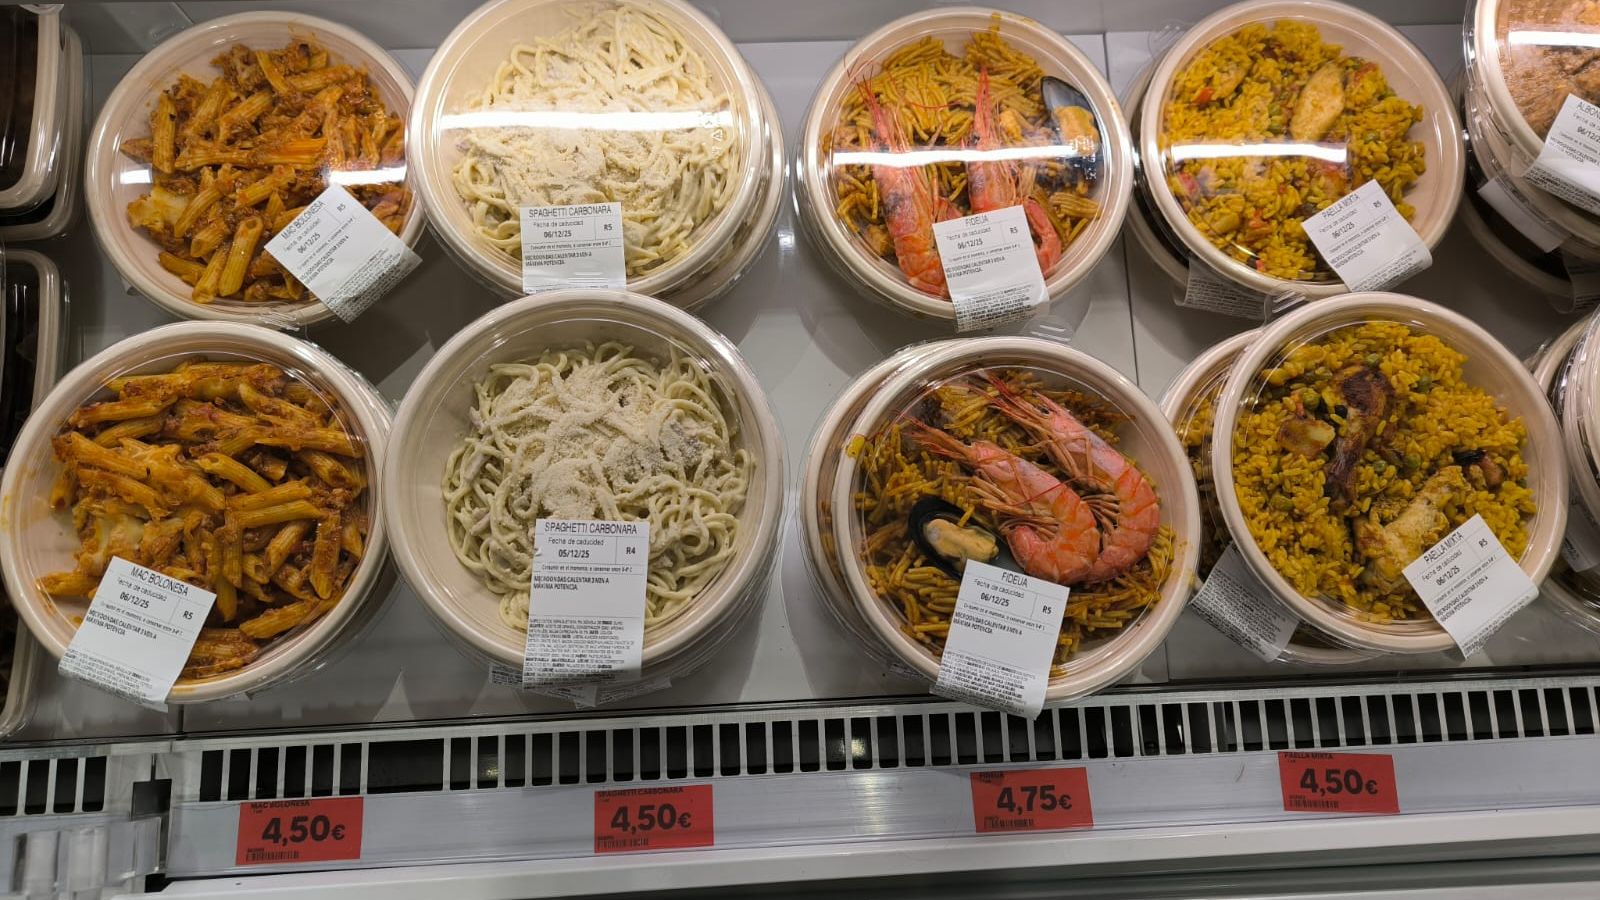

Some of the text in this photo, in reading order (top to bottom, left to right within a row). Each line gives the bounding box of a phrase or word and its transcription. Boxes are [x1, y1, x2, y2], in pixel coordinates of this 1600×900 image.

[529, 205, 611, 218] SPAGHETTI CARBONARA
[280, 223, 297, 240] MAC
[544, 230, 572, 238] 06/12/25
[1332, 223, 1355, 239] 06/12/25
[298, 233, 321, 254] 06/12/25
[958, 238, 983, 249] 06/12/25
[544, 522, 638, 534] SPAGHETTI CARBONARA
[625, 547, 636, 555] R4
[1424, 532, 1464, 564] PAELLA MIXTA
[1478, 538, 1488, 548] R5
[558, 549, 590, 558] 05/12/25
[130, 567, 189, 596] MAC BOLONESA
[1001, 572, 1028, 588] FIDEUA
[1436, 565, 1460, 586] 06/12/25
[119, 592, 150, 609] 06/12/25
[980, 592, 1011, 607] 06/12/25
[182, 610, 194, 621] R5
[1042, 604, 1052, 615] R5
[1300, 768, 1378, 796] 4,50€
[997, 785, 1073, 815] 4,75€
[611, 803, 692, 834] 4,50€
[261, 815, 346, 846] 4,50€
